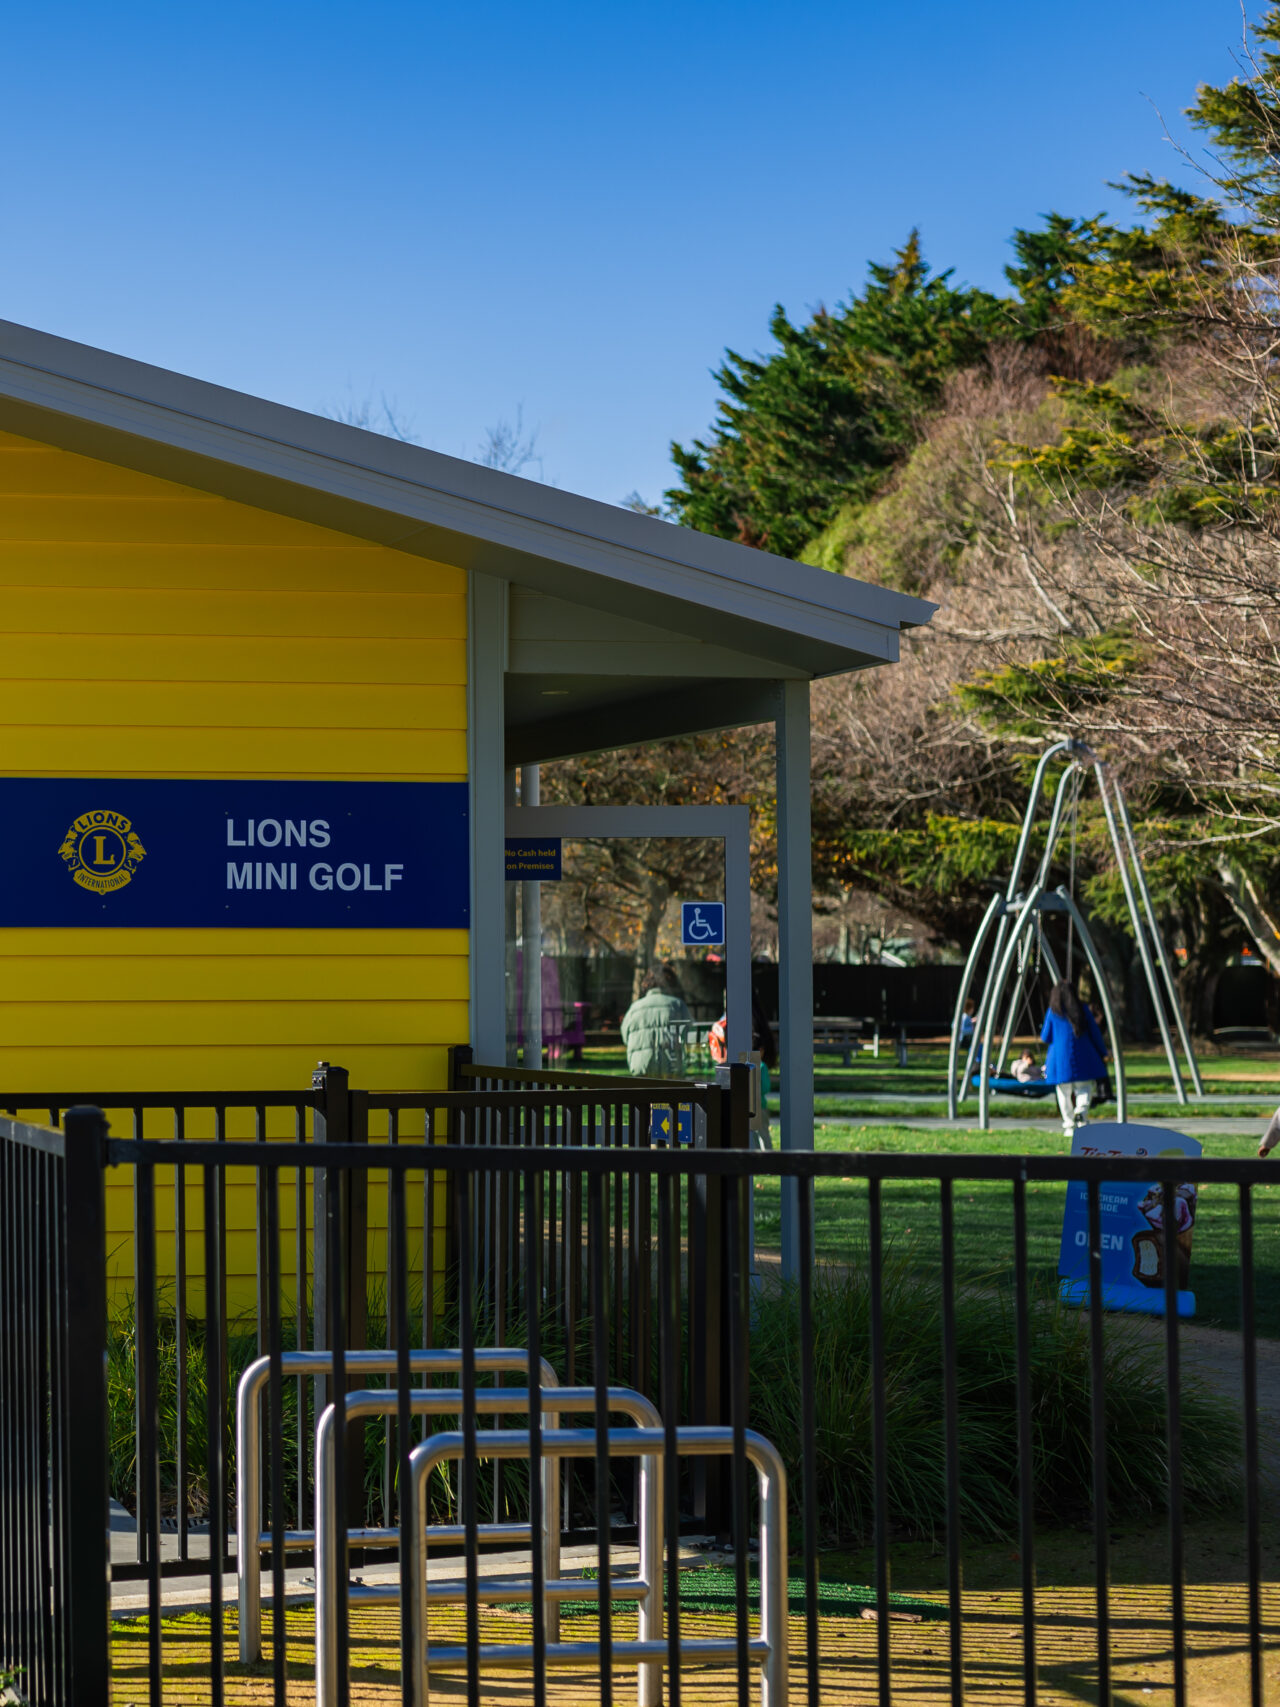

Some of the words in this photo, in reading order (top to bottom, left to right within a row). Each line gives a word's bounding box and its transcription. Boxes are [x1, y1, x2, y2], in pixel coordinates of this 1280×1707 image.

[77, 812, 129, 831] LIONS
[226, 818, 331, 848] LIONS
[93, 836, 115, 865] L
[518, 849, 537, 857] Cash
[538, 849, 556, 857] held
[518, 862, 554, 870] Premises
[77, 873, 128, 889] INTERNATIONAL
[226, 862, 298, 890] MINI
[308, 863, 404, 892] GOLF
[1075, 1230, 1124, 1251] OEN
